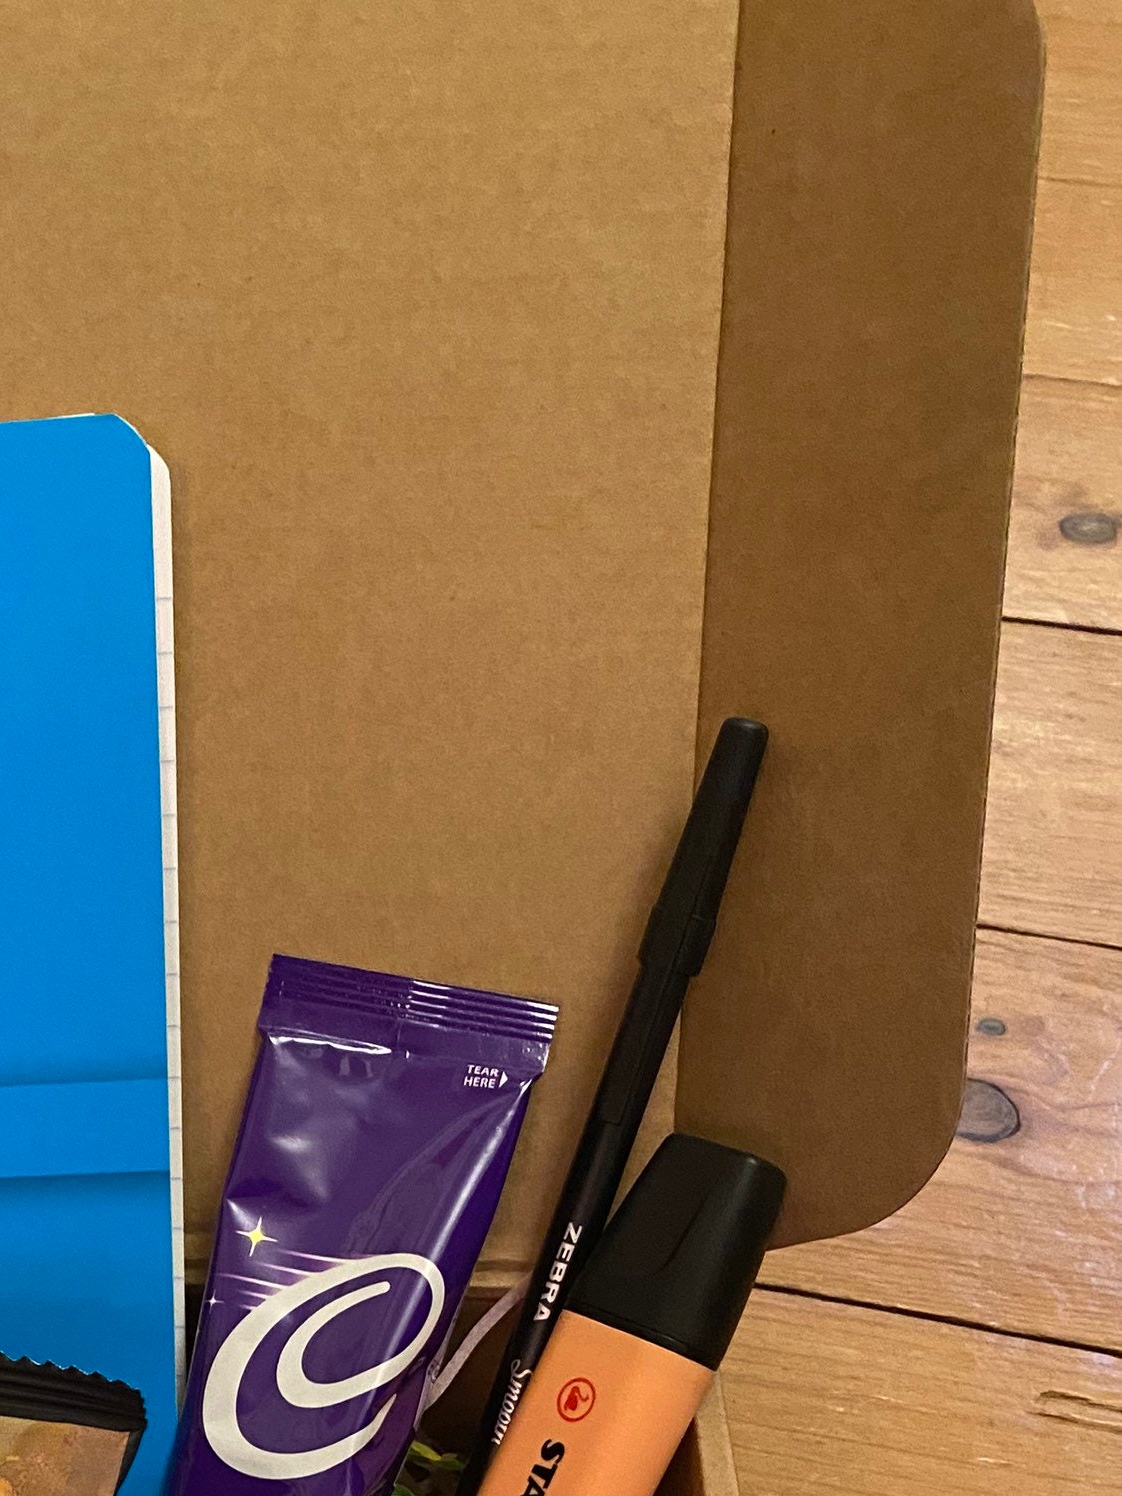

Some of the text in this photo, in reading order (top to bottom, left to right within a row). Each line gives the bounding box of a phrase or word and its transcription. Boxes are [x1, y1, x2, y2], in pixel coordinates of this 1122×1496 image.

[467, 1064, 499, 1077] TEAR
[463, 1076, 496, 1089] HERE
[533, 1221, 582, 1321] ZEBRA
